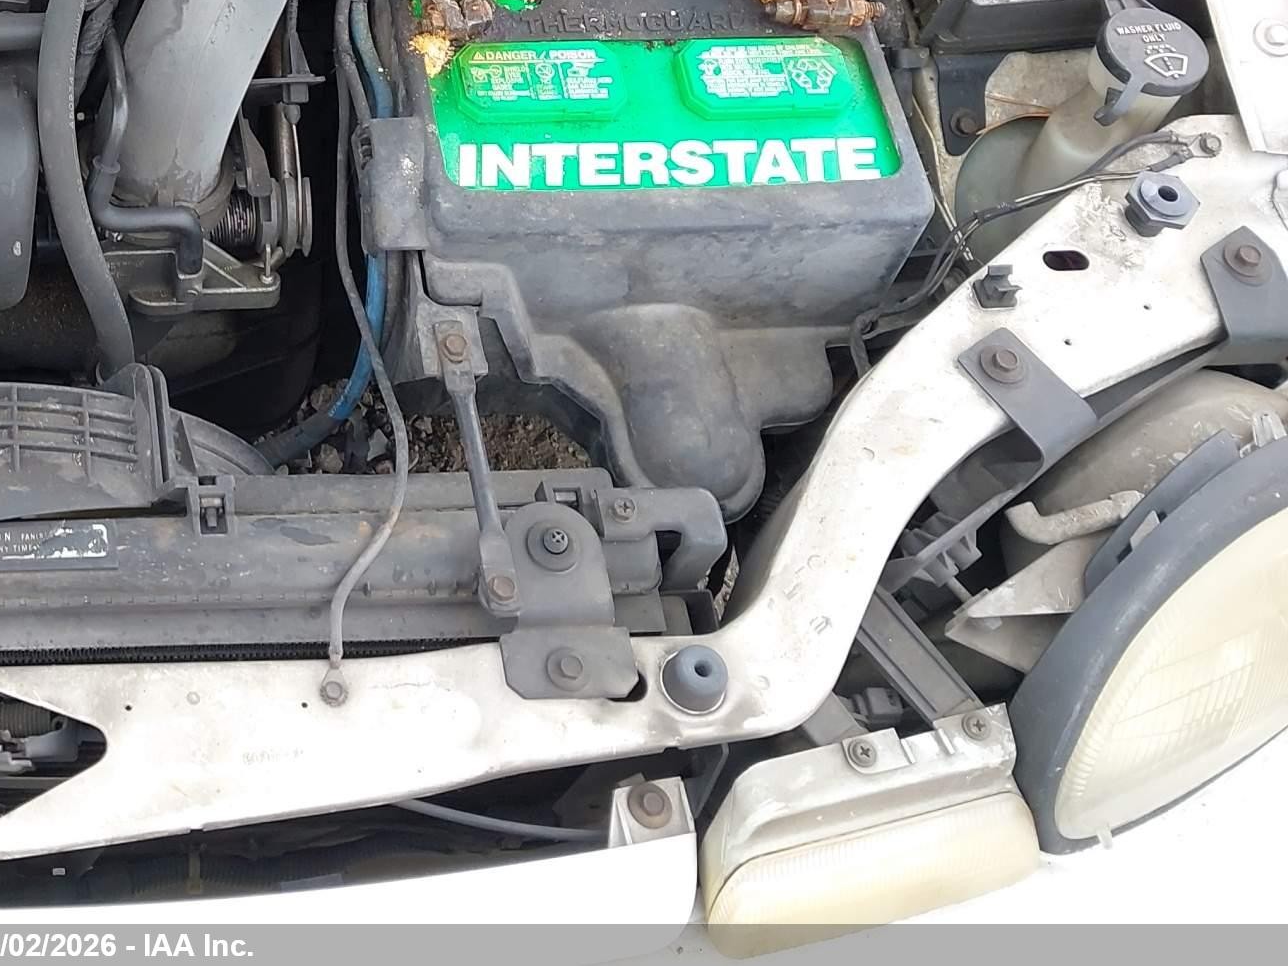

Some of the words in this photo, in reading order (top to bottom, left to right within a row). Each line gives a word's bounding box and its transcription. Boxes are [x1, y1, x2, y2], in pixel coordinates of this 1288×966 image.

[1116, 24, 1152, 35] WASHER
[1155, 21, 1182, 32] FLUID
[1143, 33, 1166, 42] ONLY
[486, 50, 537, 61] DANGER
[550, 49, 596, 59] POISON
[459, 137, 881, 189] INTERSTATE
